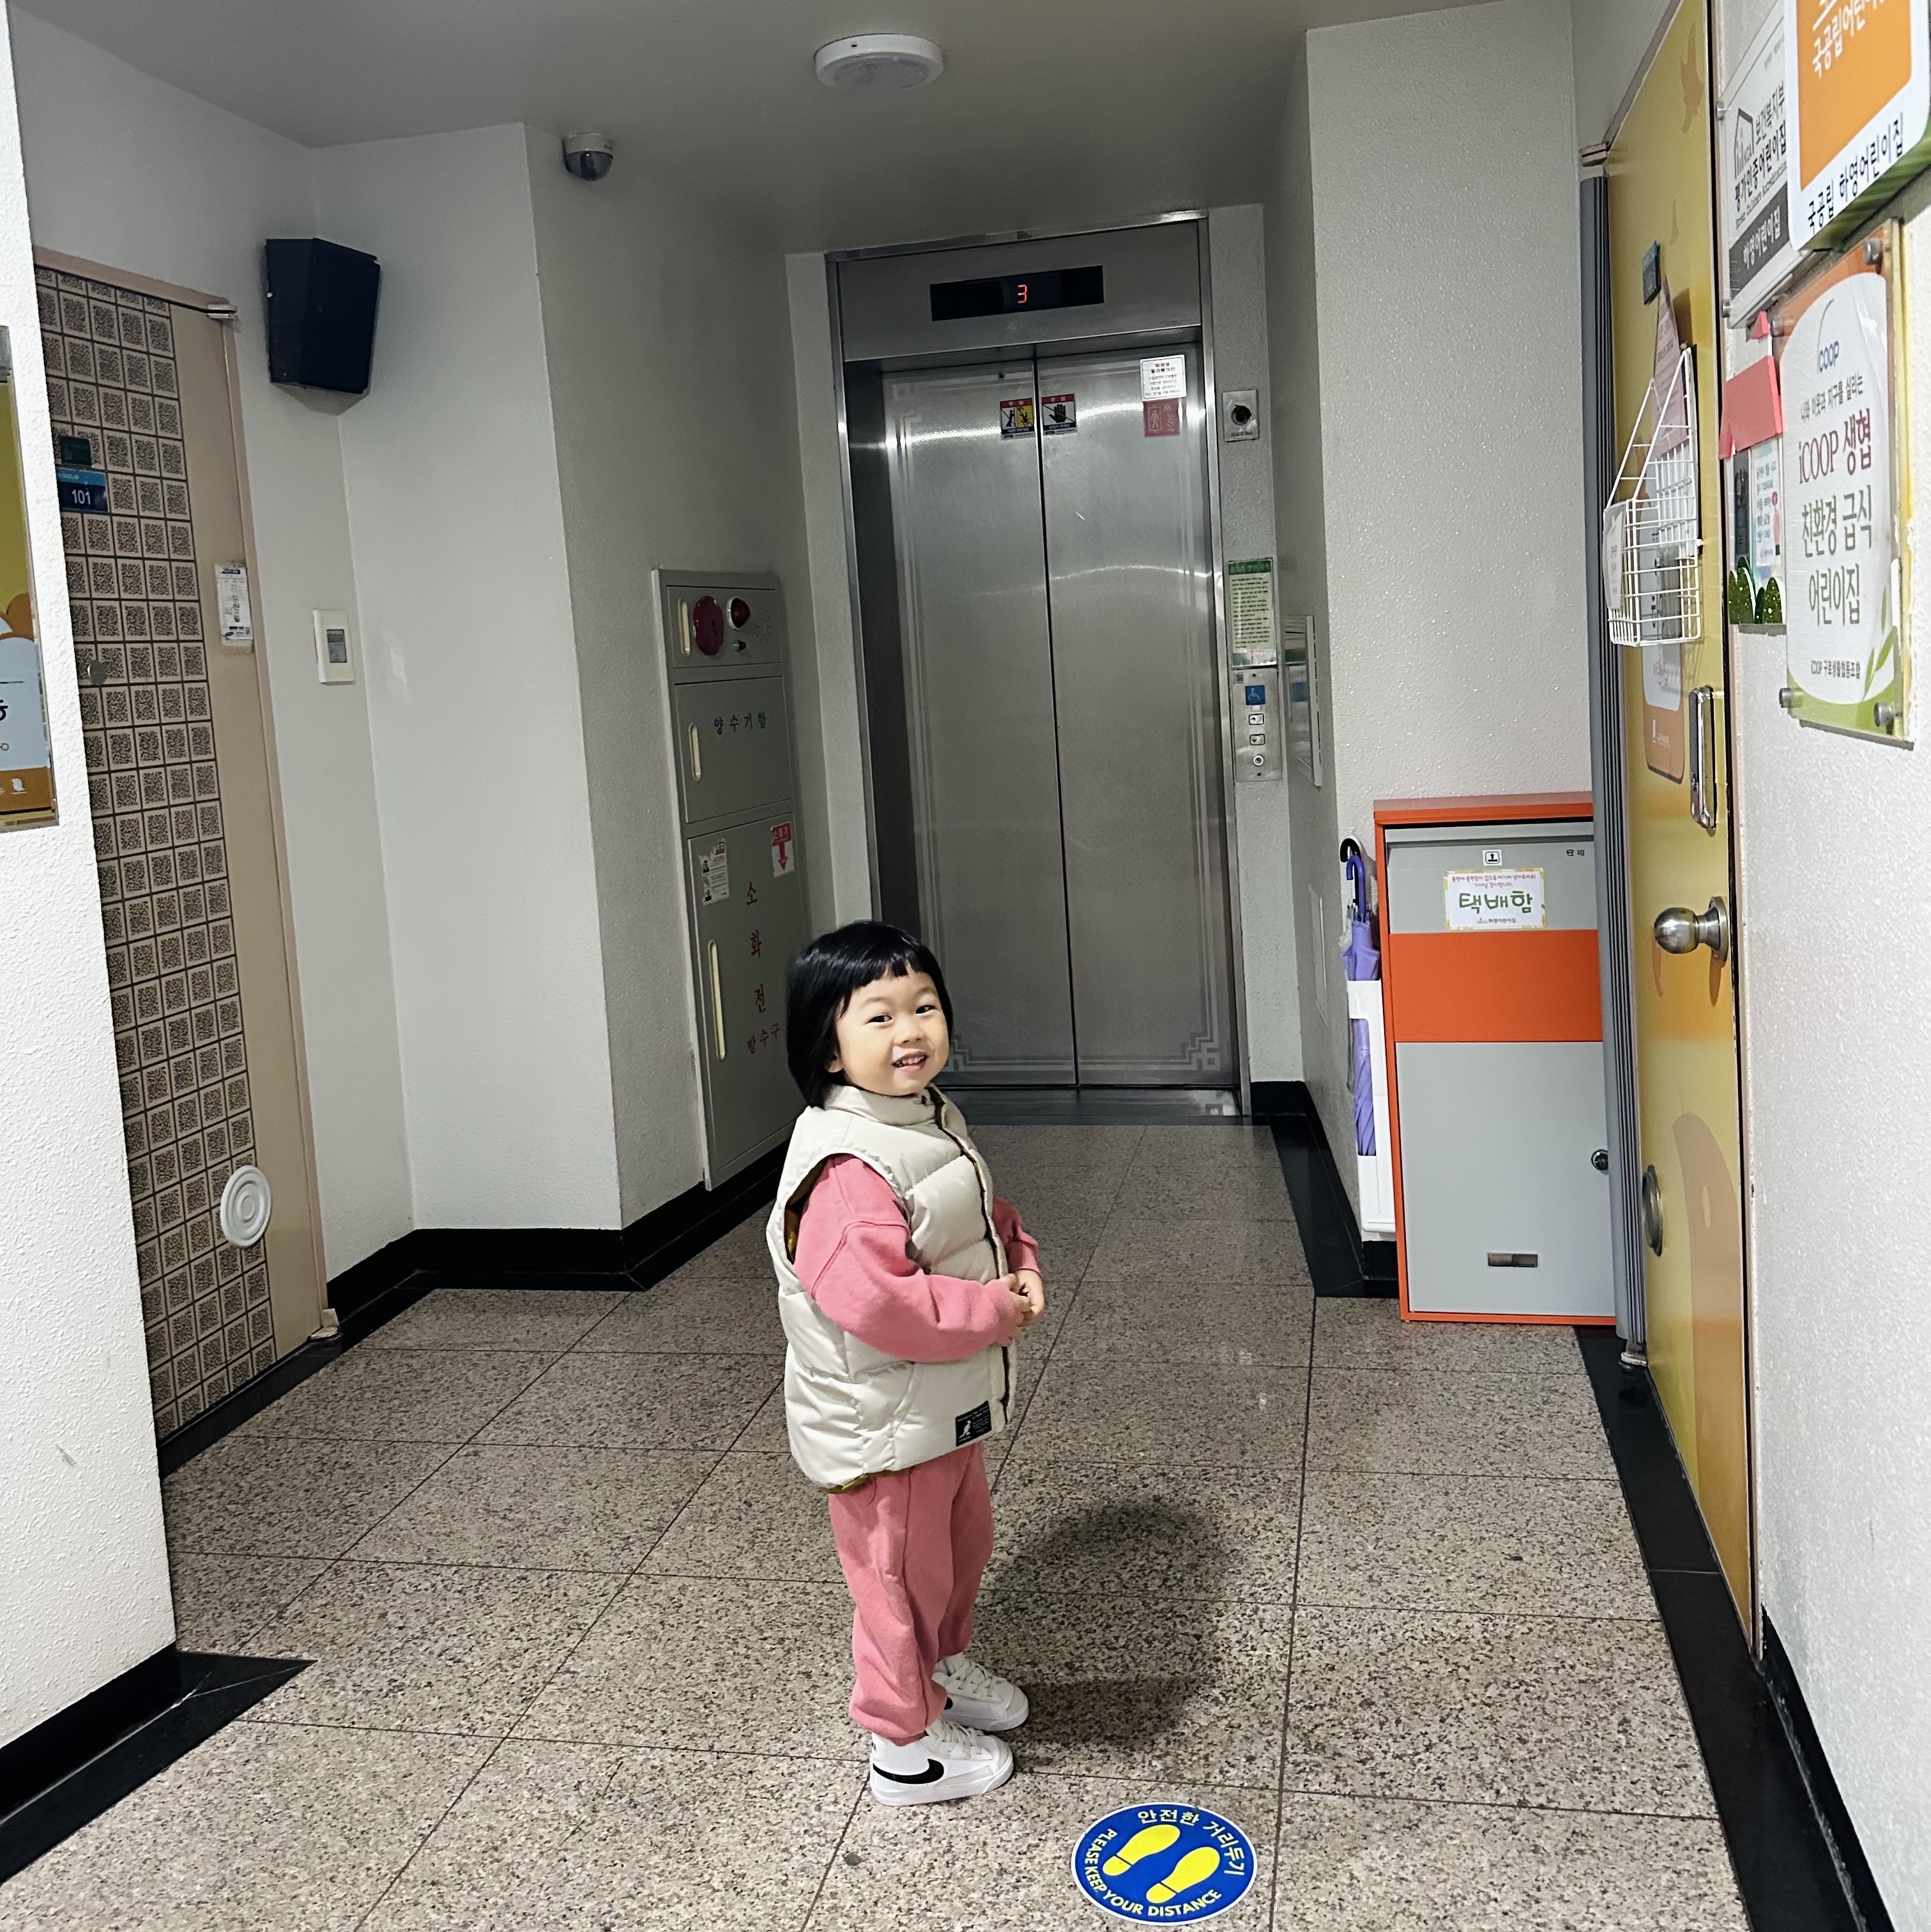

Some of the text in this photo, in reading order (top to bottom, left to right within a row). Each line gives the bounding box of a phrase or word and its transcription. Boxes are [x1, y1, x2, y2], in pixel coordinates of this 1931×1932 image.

[1735, 119, 1787, 211] 평가인증어린이집
[1808, 111, 1904, 235] 국공립 하영어린이집
[1743, 206, 1781, 270] 하영어린이집
[1018, 284, 1027, 303] 3
[1828, 381, 1843, 409] 지구를
[1846, 371, 1863, 397] 살리는
[1799, 407, 1872, 484] iCOOP 생협
[72, 489, 91, 505] 101
[1802, 494, 1837, 558] 친환경
[1842, 484, 1872, 549] 급식
[1809, 563, 1860, 626] 어린이집
[1459, 890, 1532, 914] 택배함
[747, 1023, 780, 1054] 방수구
[1085, 1828, 1222, 1917] PLEASE KEEP YOUR DISTANCE
[1138, 1809, 1245, 1876] 안전한 거리두기
